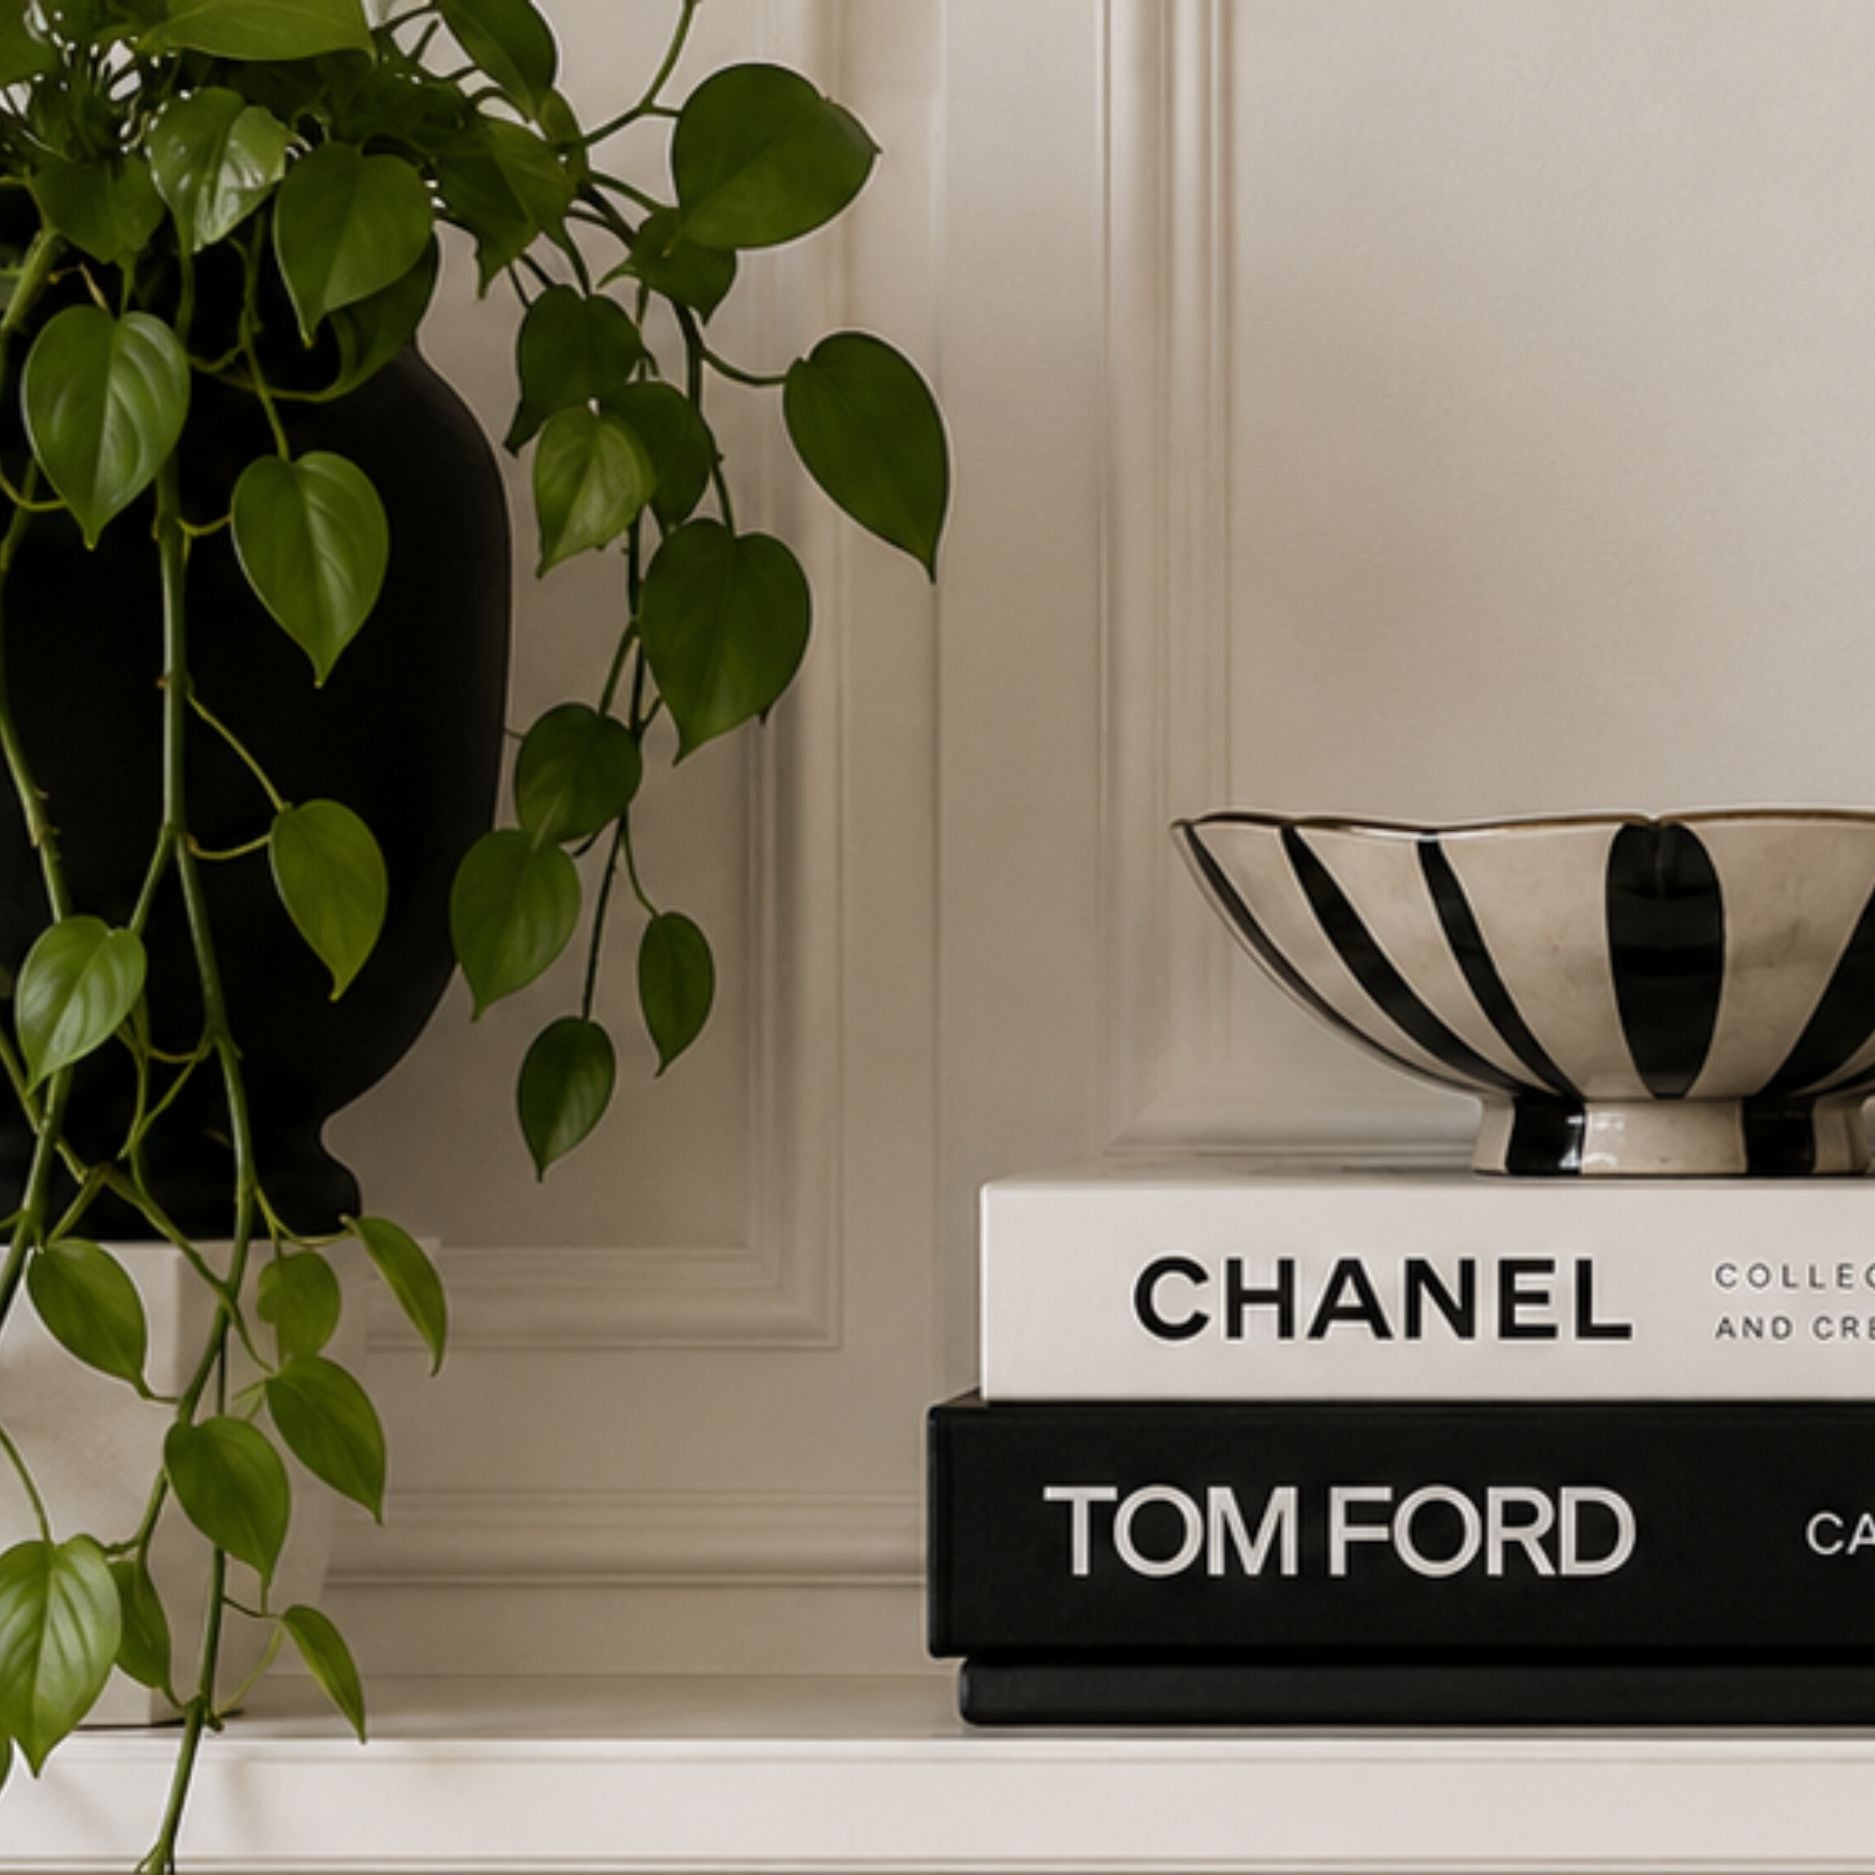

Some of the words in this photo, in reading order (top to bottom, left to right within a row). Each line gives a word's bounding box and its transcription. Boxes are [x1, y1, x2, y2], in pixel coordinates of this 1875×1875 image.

[1133, 1254, 1634, 1343] CHANEL
[1713, 1314, 1795, 1342] AND
[1041, 1483, 1299, 1579] TOM
[1328, 1483, 1637, 1579] FORD
